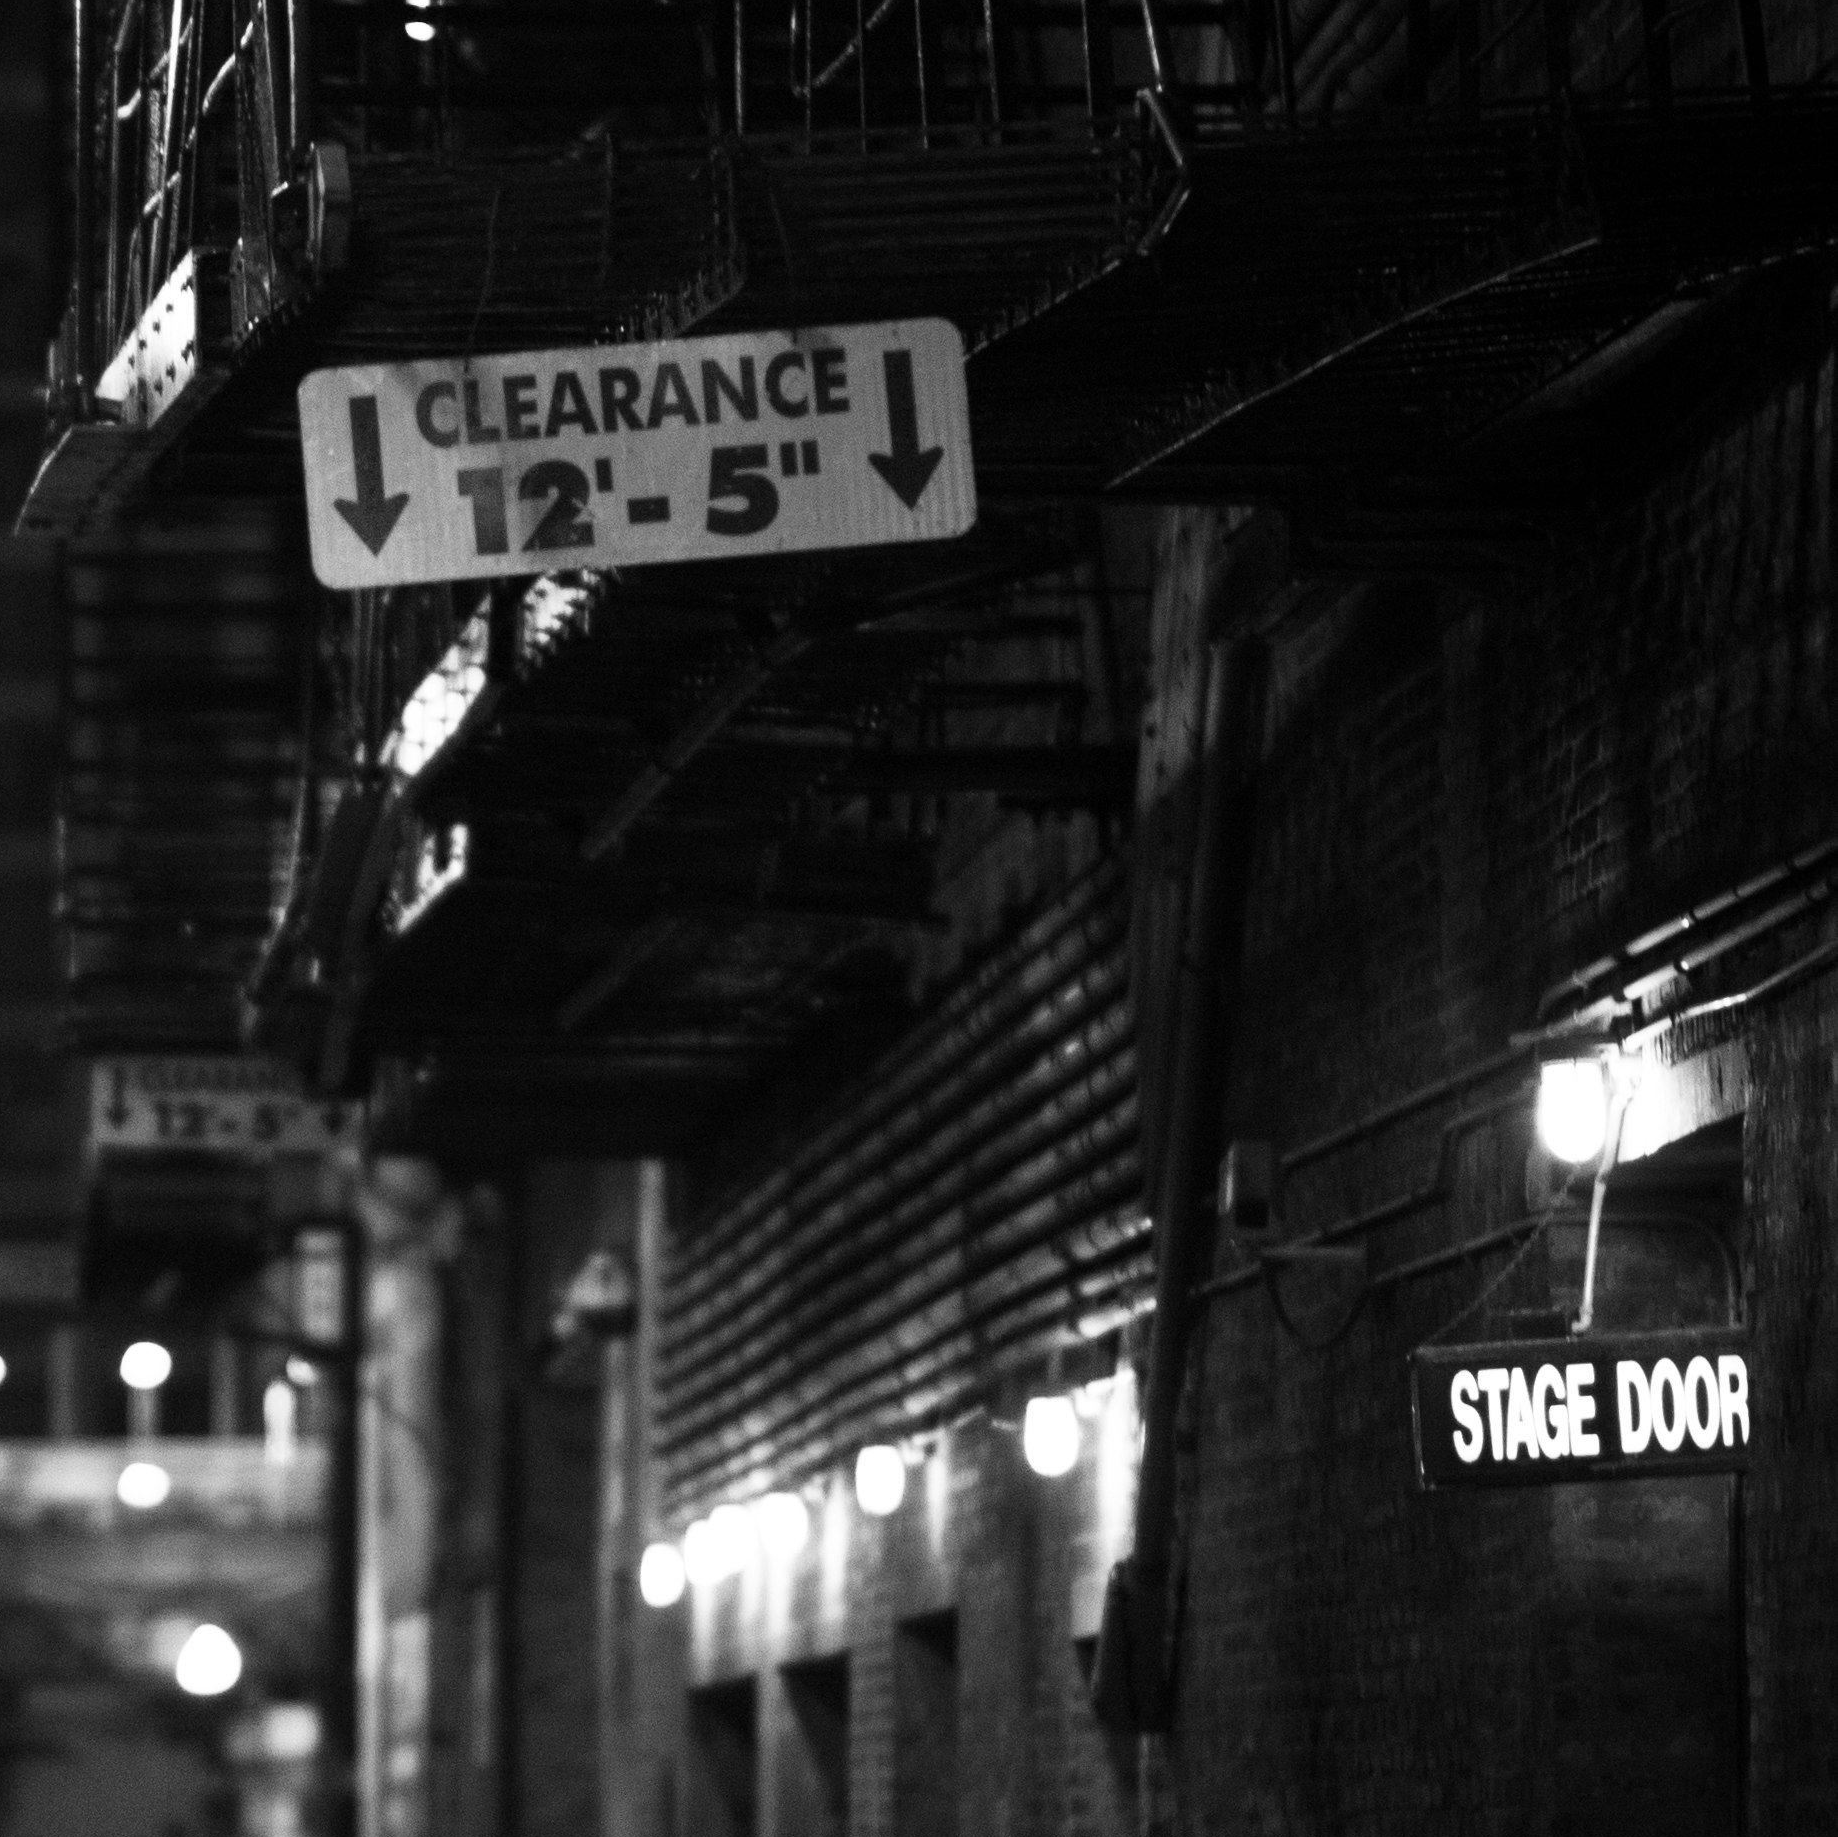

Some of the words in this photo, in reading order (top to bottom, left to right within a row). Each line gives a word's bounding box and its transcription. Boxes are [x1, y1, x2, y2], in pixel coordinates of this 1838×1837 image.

[416, 348, 850, 450] CLEARANCE
[1451, 1363, 1600, 1463] STAGE
[1616, 1355, 1750, 1454] DOOR
